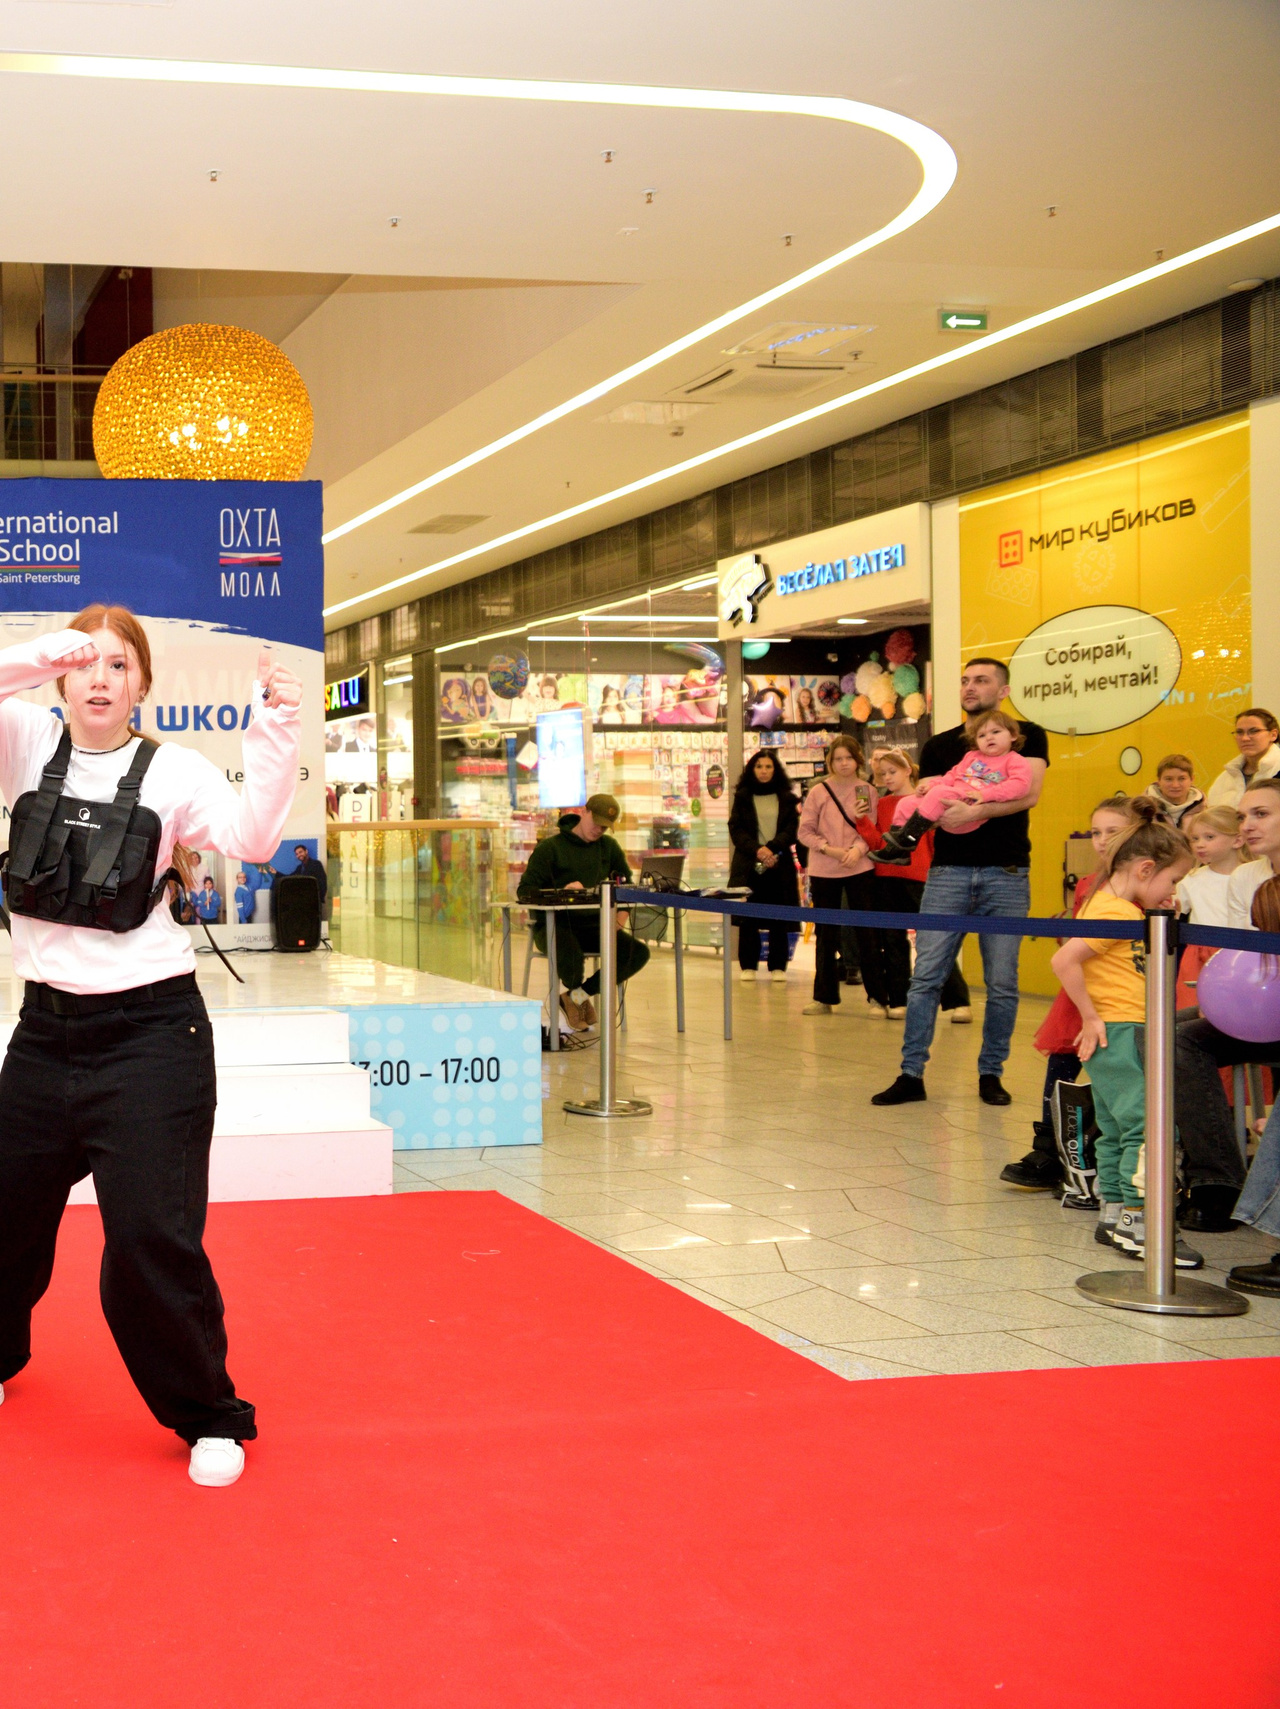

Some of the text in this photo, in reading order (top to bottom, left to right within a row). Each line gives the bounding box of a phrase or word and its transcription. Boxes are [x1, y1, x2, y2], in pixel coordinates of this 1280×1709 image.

[220, 507, 281, 548] ОХТА
[1029, 497, 1197, 552] мир кубиков
[24, 573, 81, 585] Petersburg
[221, 571, 281, 597] МОЛЛ
[776, 559, 847, 597] ВЕСЁЛАЯ
[847, 543, 905, 580] ЗАТЕЯ
[1045, 633, 1133, 667] Собирай,
[324, 676, 360, 712] SALU
[1023, 664, 1160, 702] играй, мечтай!
[441, 1056, 501, 1085] 17:00
